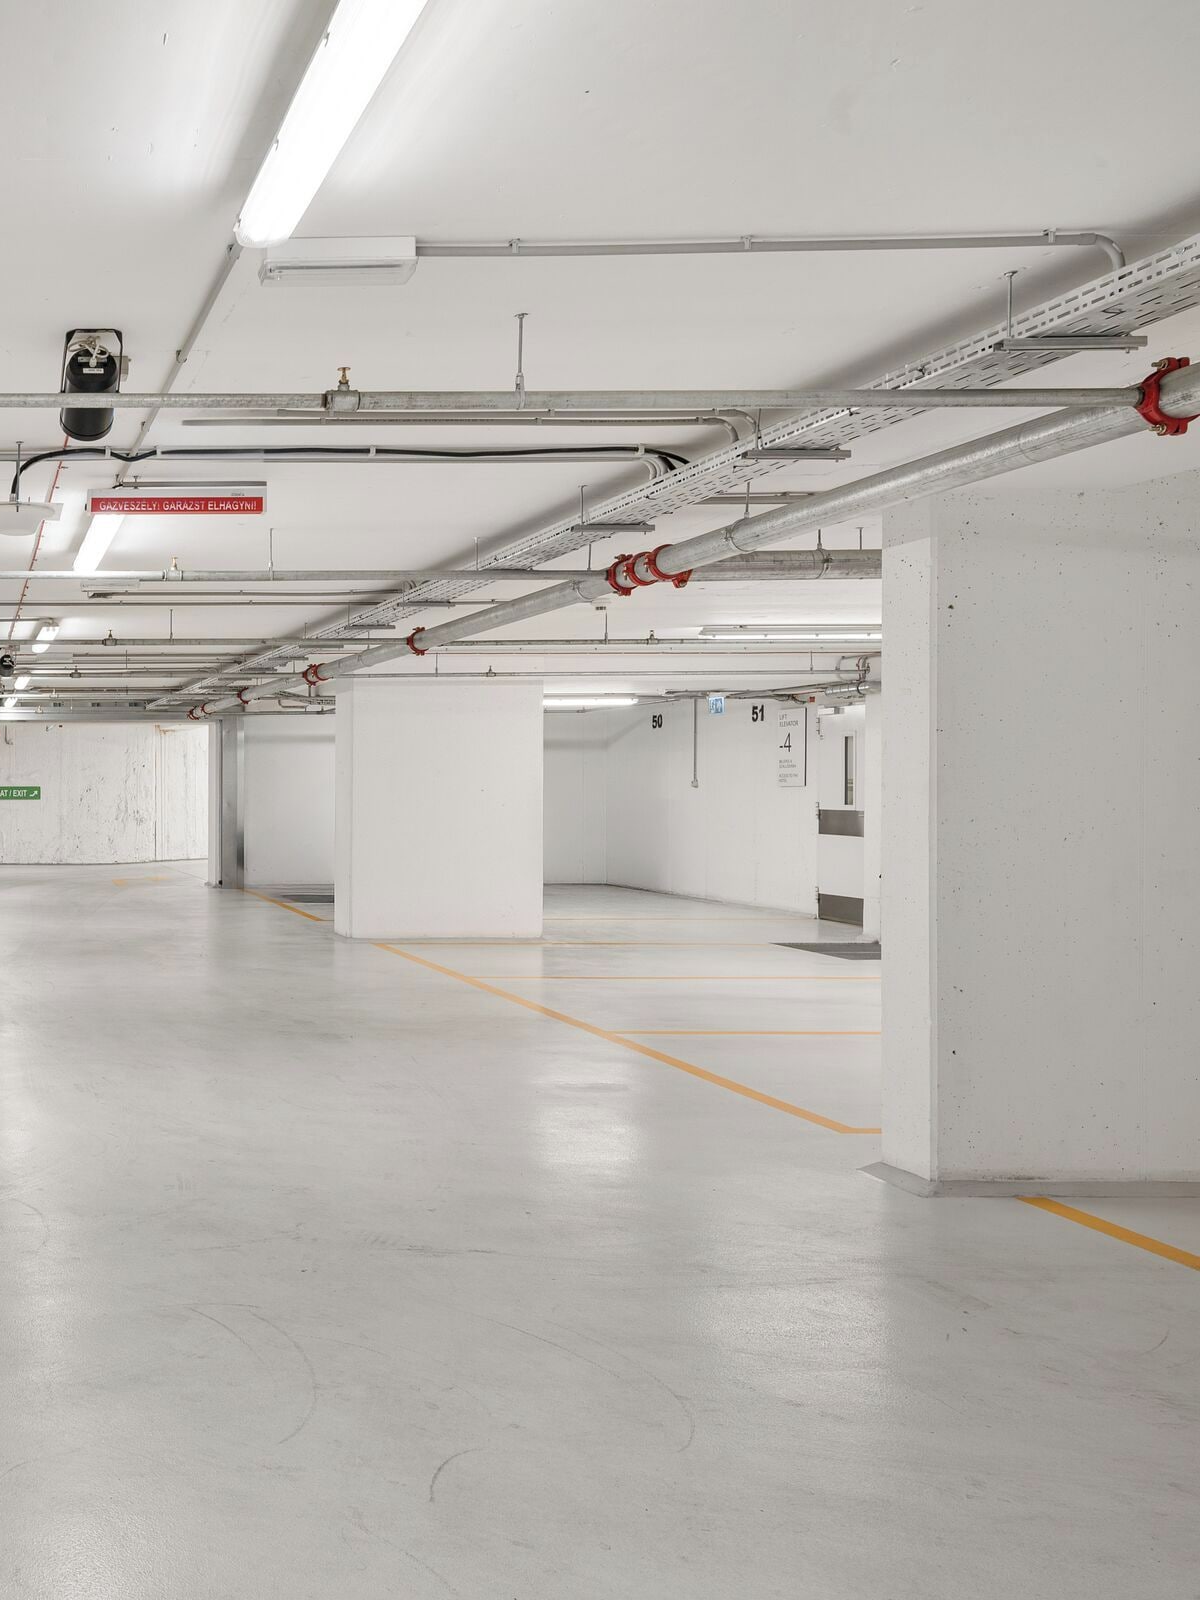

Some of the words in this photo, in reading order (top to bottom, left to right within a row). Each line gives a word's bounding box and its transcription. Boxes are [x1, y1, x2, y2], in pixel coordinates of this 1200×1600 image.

[208, 501, 256, 511] ELHAGYNI!
[751, 704, 764, 722] 51
[652, 714, 663, 729] 50
[779, 719, 799, 728] ELEVATOR
[779, 732, 792, 752] -4
[13, 789, 27, 797] EXIT
